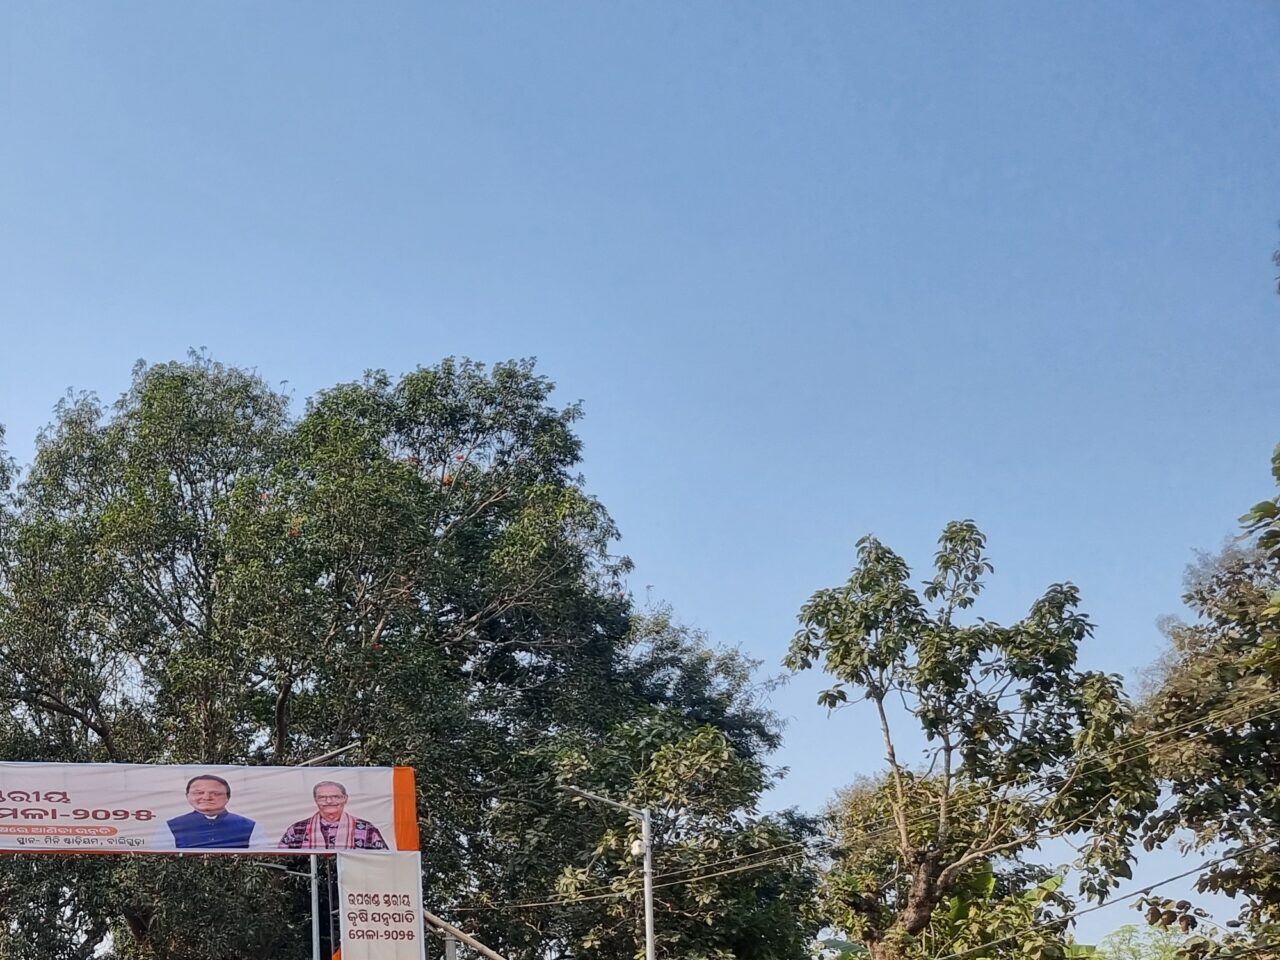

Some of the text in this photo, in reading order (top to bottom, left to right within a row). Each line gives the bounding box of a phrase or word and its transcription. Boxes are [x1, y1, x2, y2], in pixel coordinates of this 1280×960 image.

[348, 893, 411, 907] ଉପଖଣ୍ଡ ସ୍ତରୀୟ
[347, 909, 415, 926] କୃଷି ଯନ୍ତ୍ରପାତି
[348, 929, 416, 941] ମେଳା-୨୦୨୫
